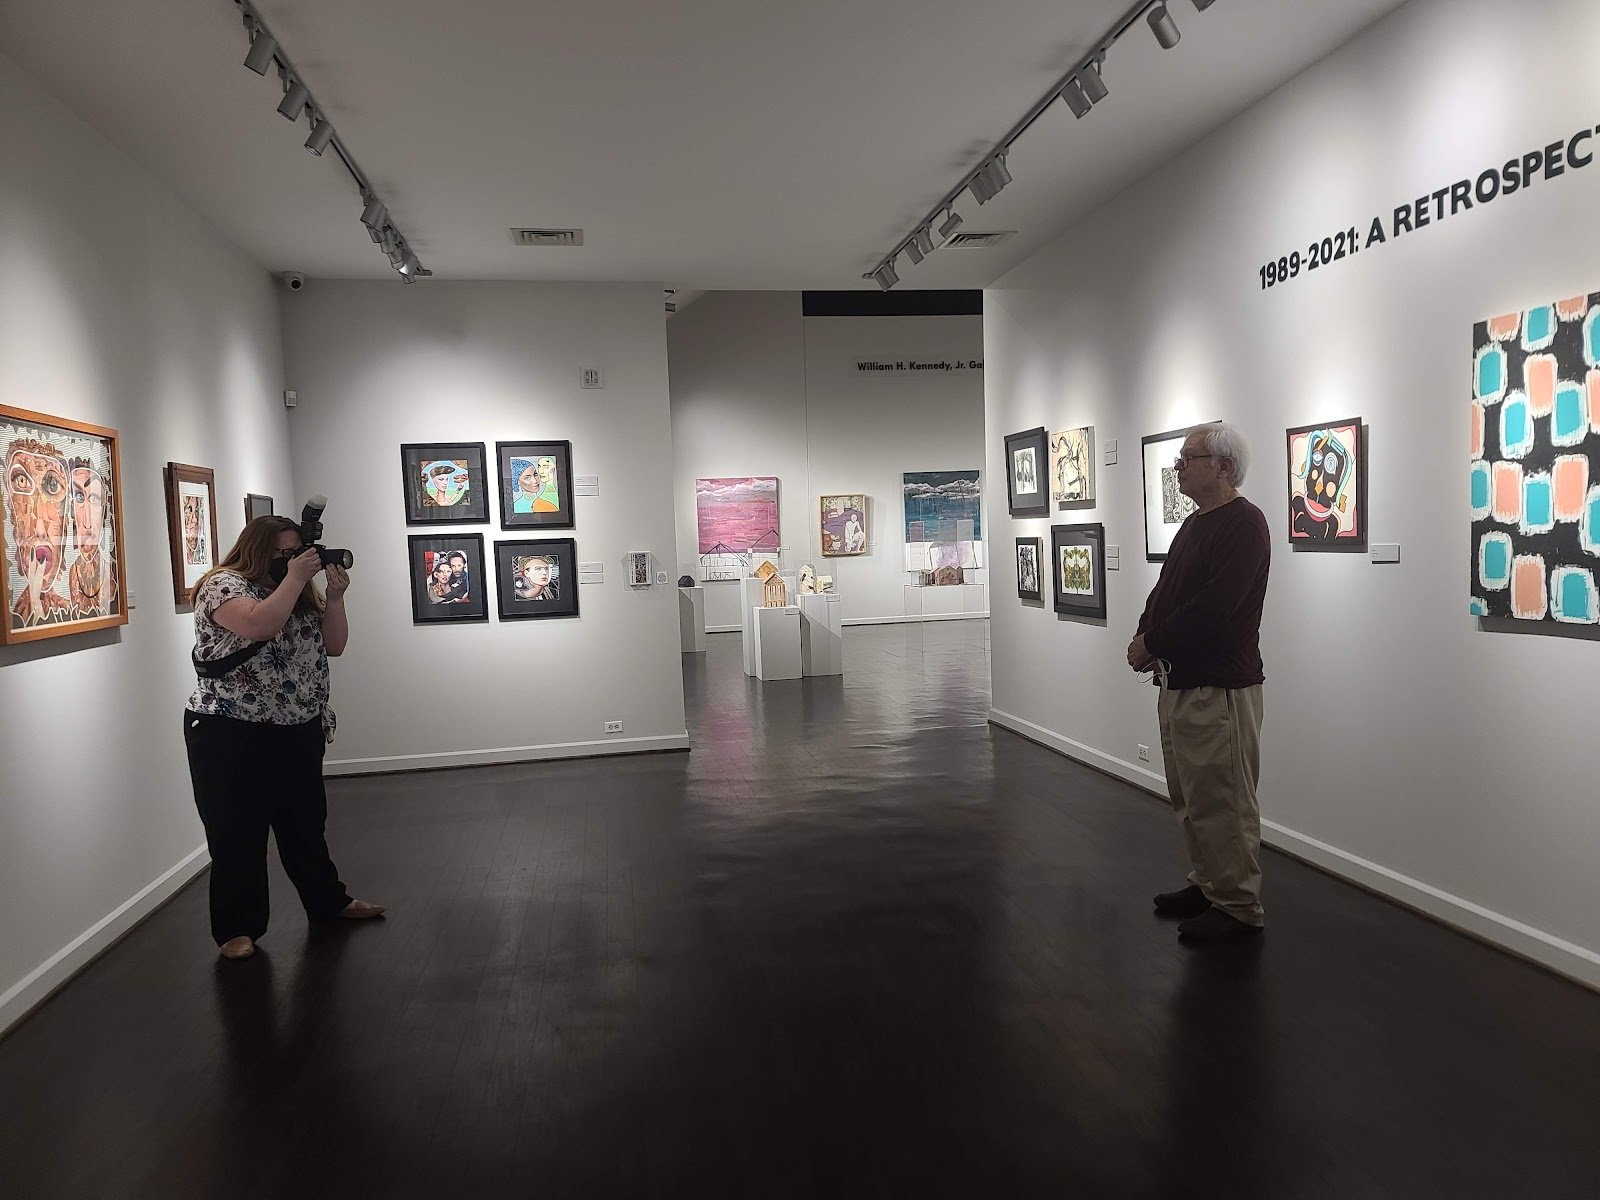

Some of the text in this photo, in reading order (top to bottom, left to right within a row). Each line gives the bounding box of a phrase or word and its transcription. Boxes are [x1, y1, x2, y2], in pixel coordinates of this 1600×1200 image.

[1259, 124, 1600, 290] 1989-2021: A RETROSPEC
[857, 361, 893, 371] William
[896, 361, 907, 370] H.
[909, 360, 953, 371] Kennedy,
[955, 360, 967, 370] Jr.
